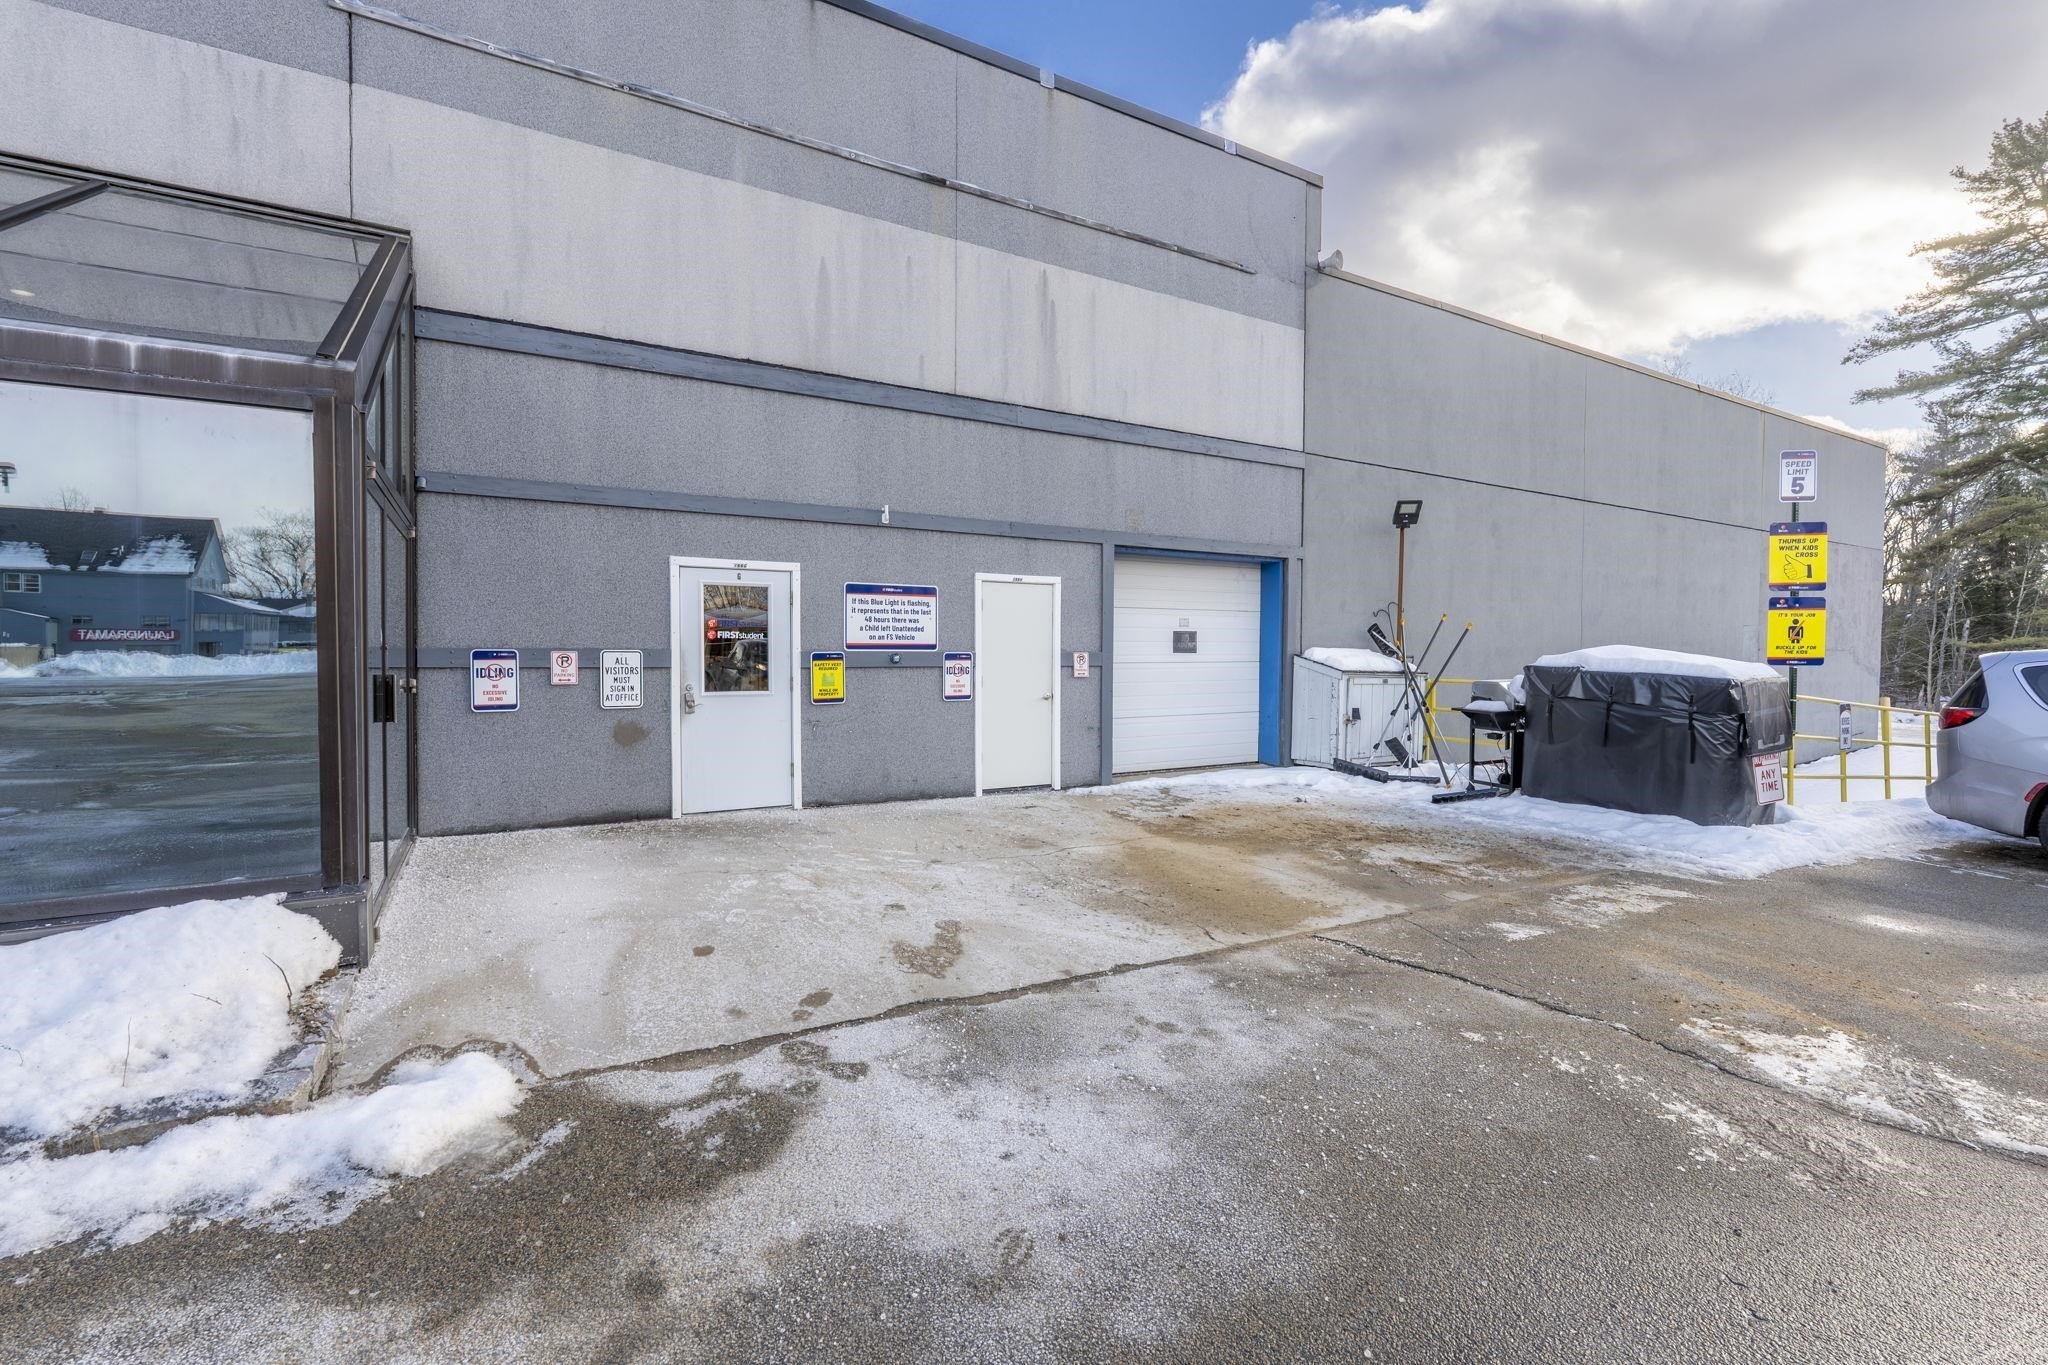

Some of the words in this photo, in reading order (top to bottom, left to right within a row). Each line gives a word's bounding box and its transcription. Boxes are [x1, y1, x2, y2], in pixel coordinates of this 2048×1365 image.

[1790, 476, 1805, 494] 5
[614, 657, 629, 665] ALL
[476, 668, 514, 678] IDLING
[946, 666, 969, 675] IDLING
[1761, 768, 1776, 780] ANY
[1761, 781, 1779, 792] TIME
